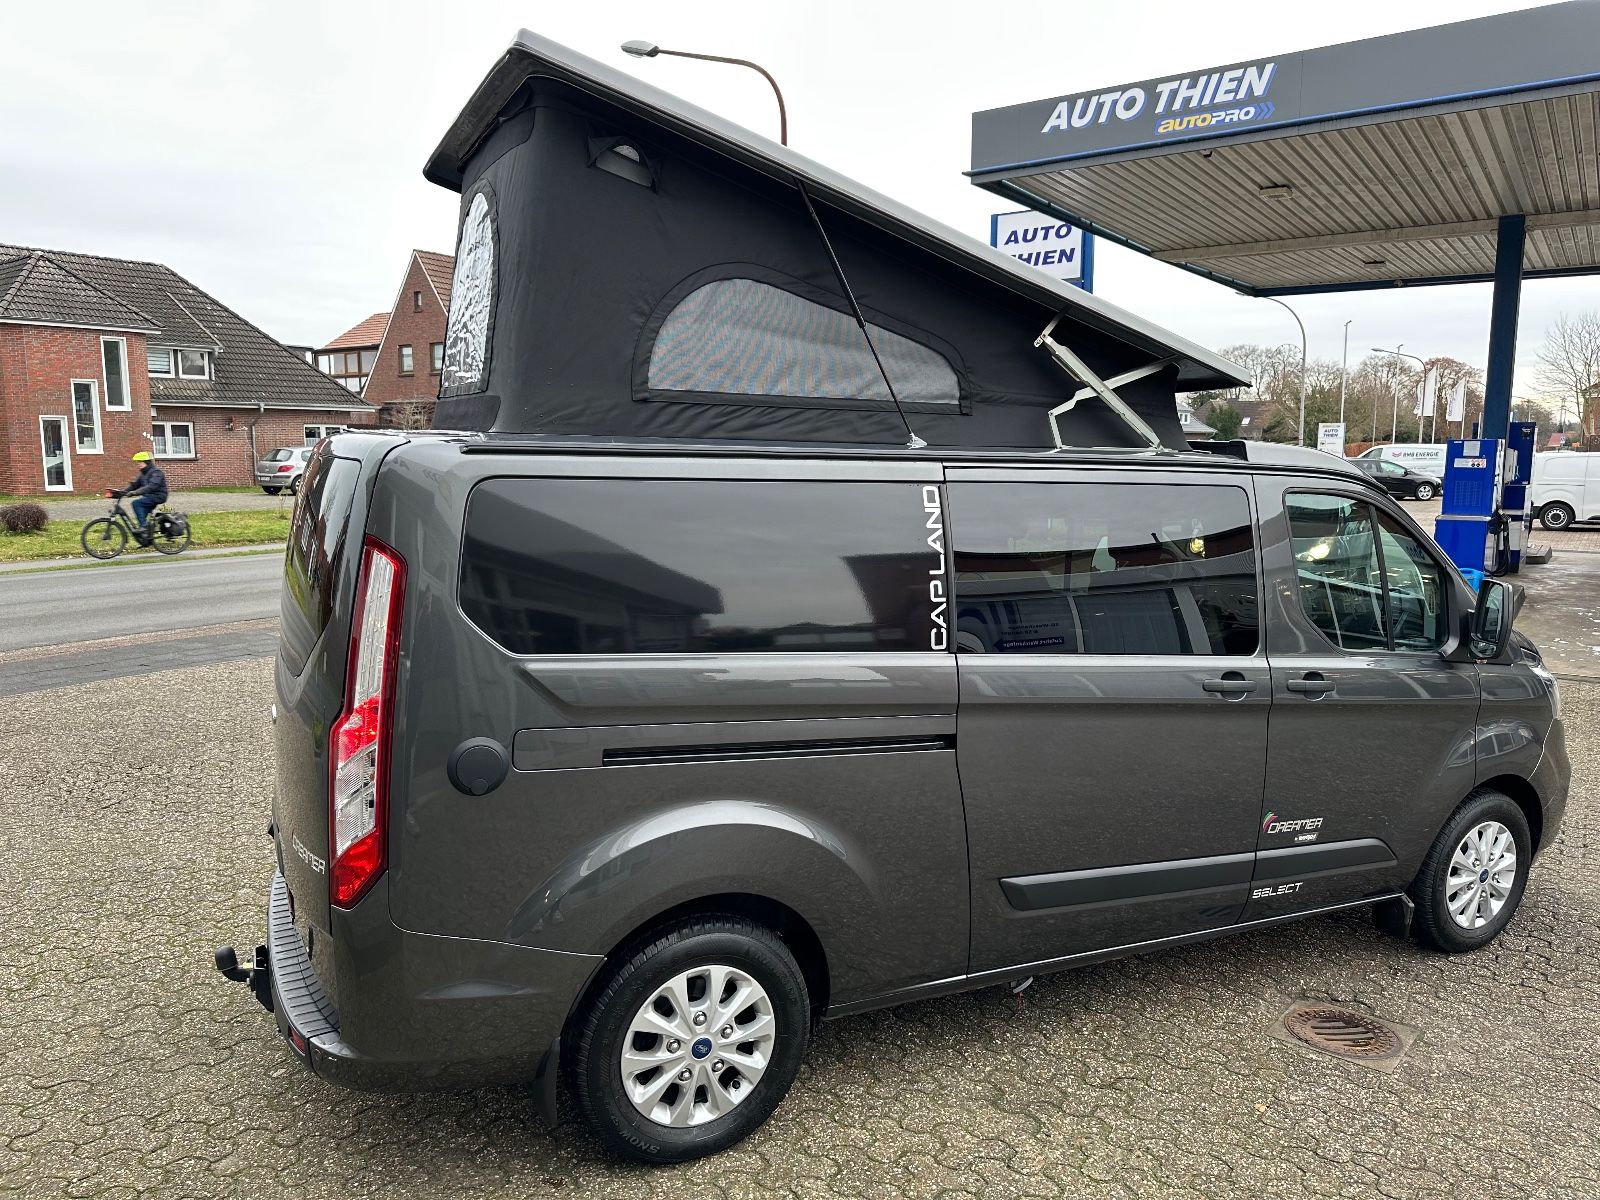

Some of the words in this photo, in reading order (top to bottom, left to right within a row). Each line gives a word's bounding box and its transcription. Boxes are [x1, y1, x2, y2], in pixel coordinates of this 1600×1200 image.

[1041, 87, 1147, 134] AUTO
[1155, 63, 1276, 114] THIEN
[1004, 223, 1072, 246] AUTO
[1011, 247, 1076, 267] HIEN
[1267, 818, 1323, 833] DREAMER
[1252, 882, 1303, 898] SELECT
